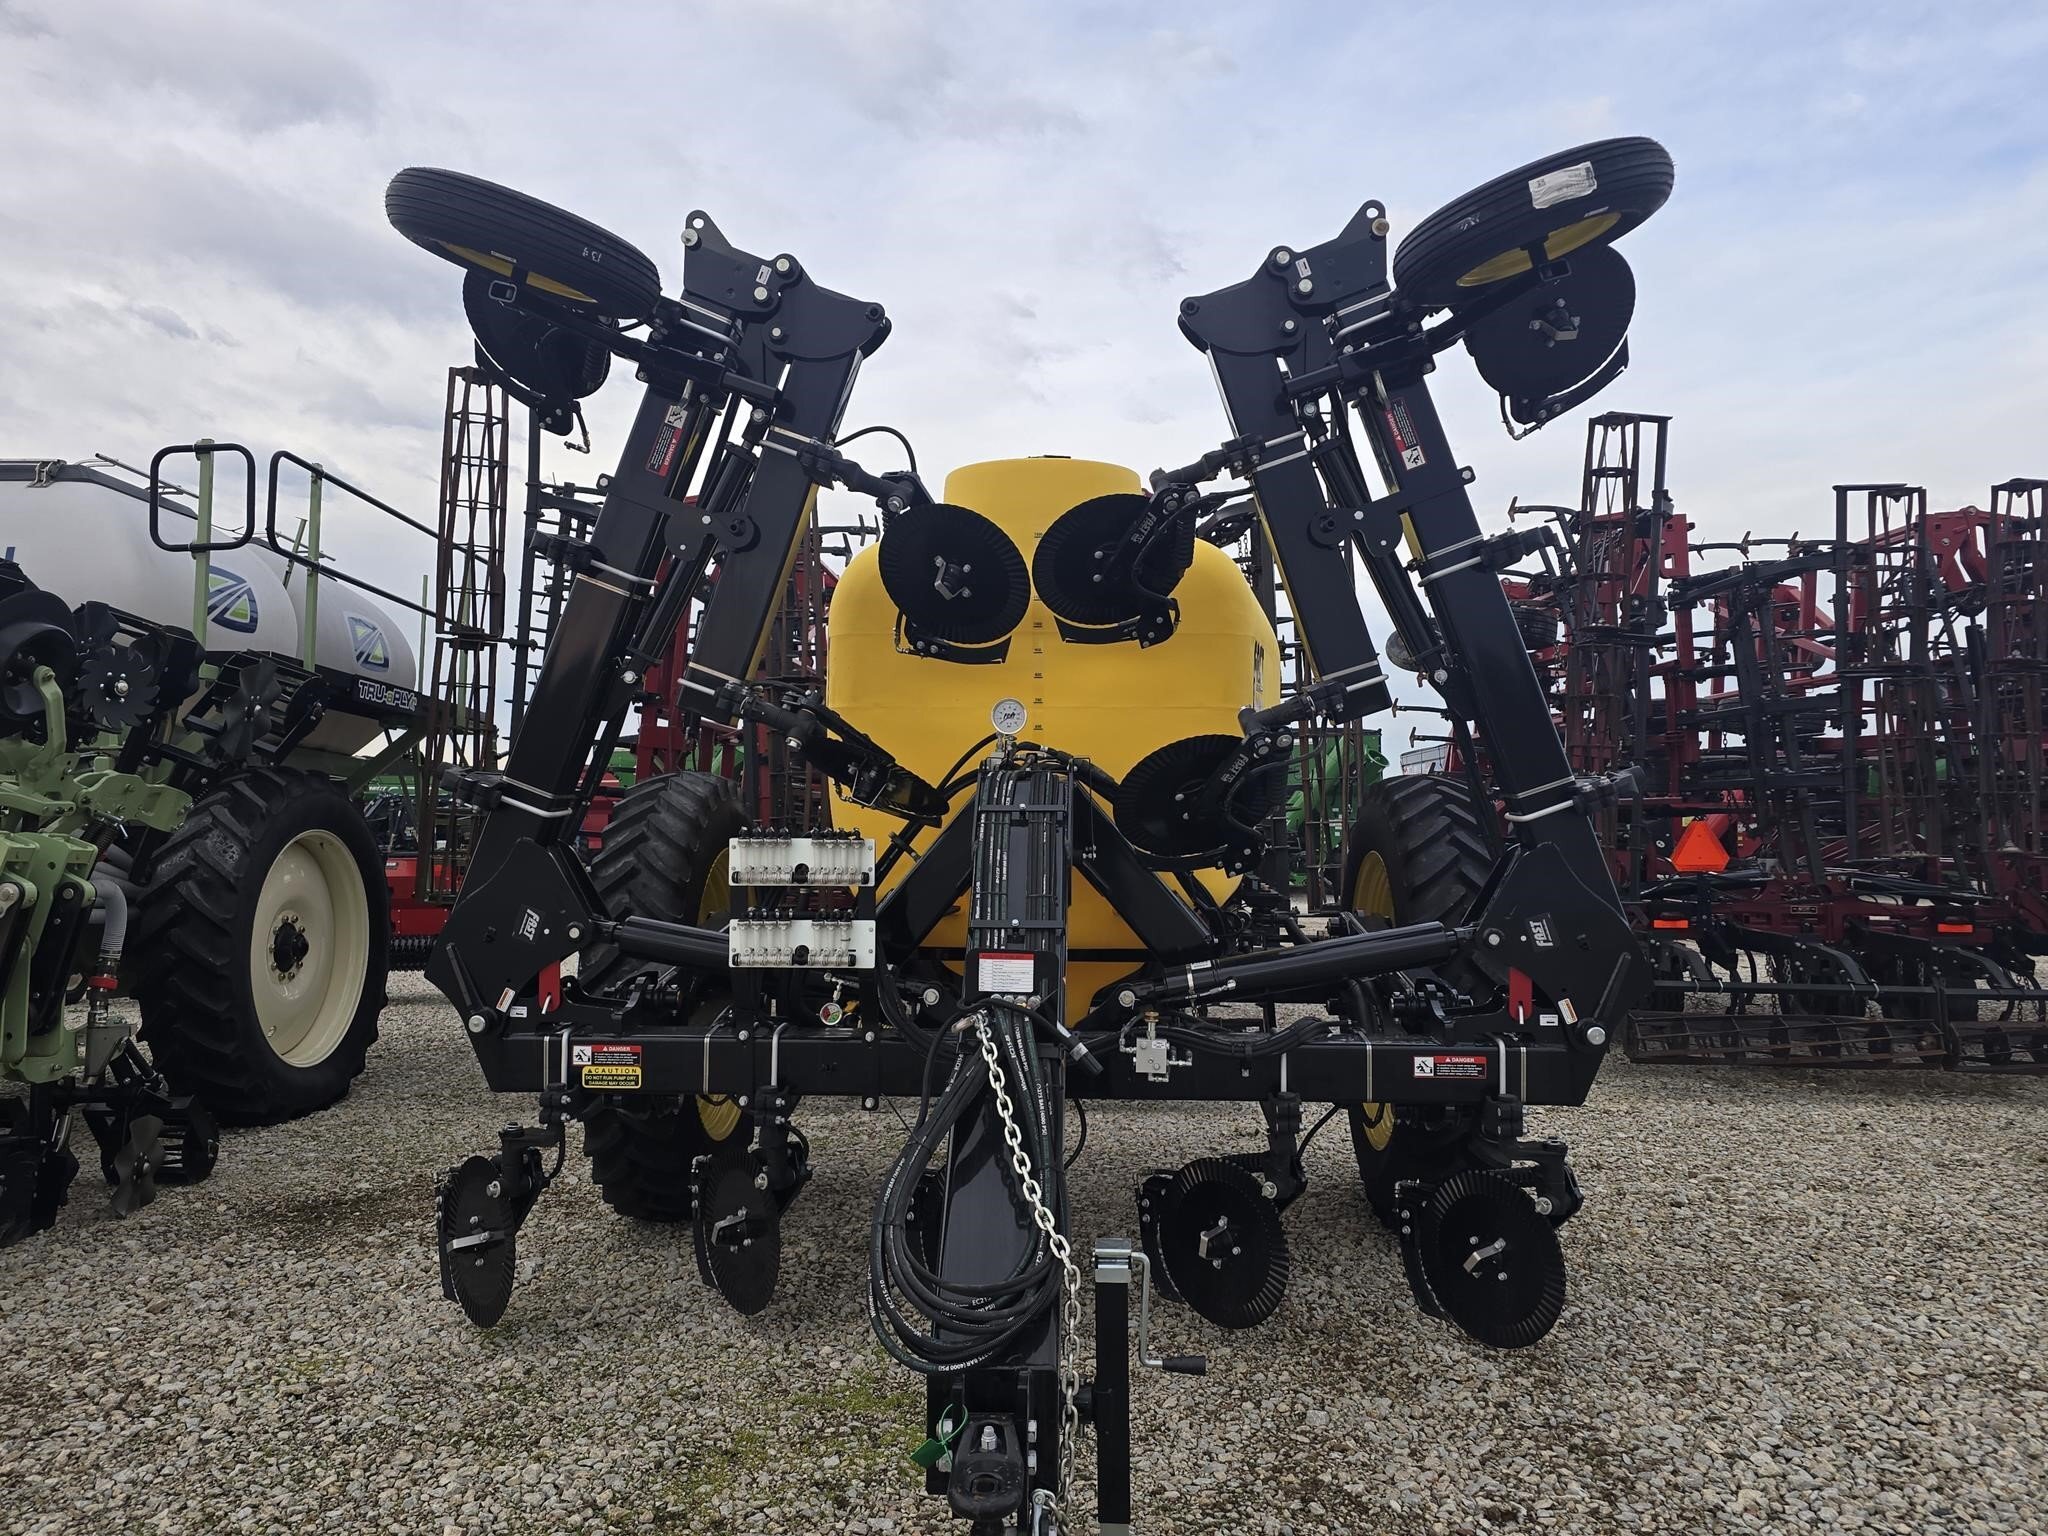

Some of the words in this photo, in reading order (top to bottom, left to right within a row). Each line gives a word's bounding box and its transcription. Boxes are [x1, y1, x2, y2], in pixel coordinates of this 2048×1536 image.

[663, 443, 674, 465] DANGER
[524, 908, 540, 941] FAST
[1529, 920, 1553, 946] FAST
[880, 1279, 894, 1308] EC215-10
[937, 1364, 949, 1372] PSI)
[965, 1357, 978, 1366] BAR
